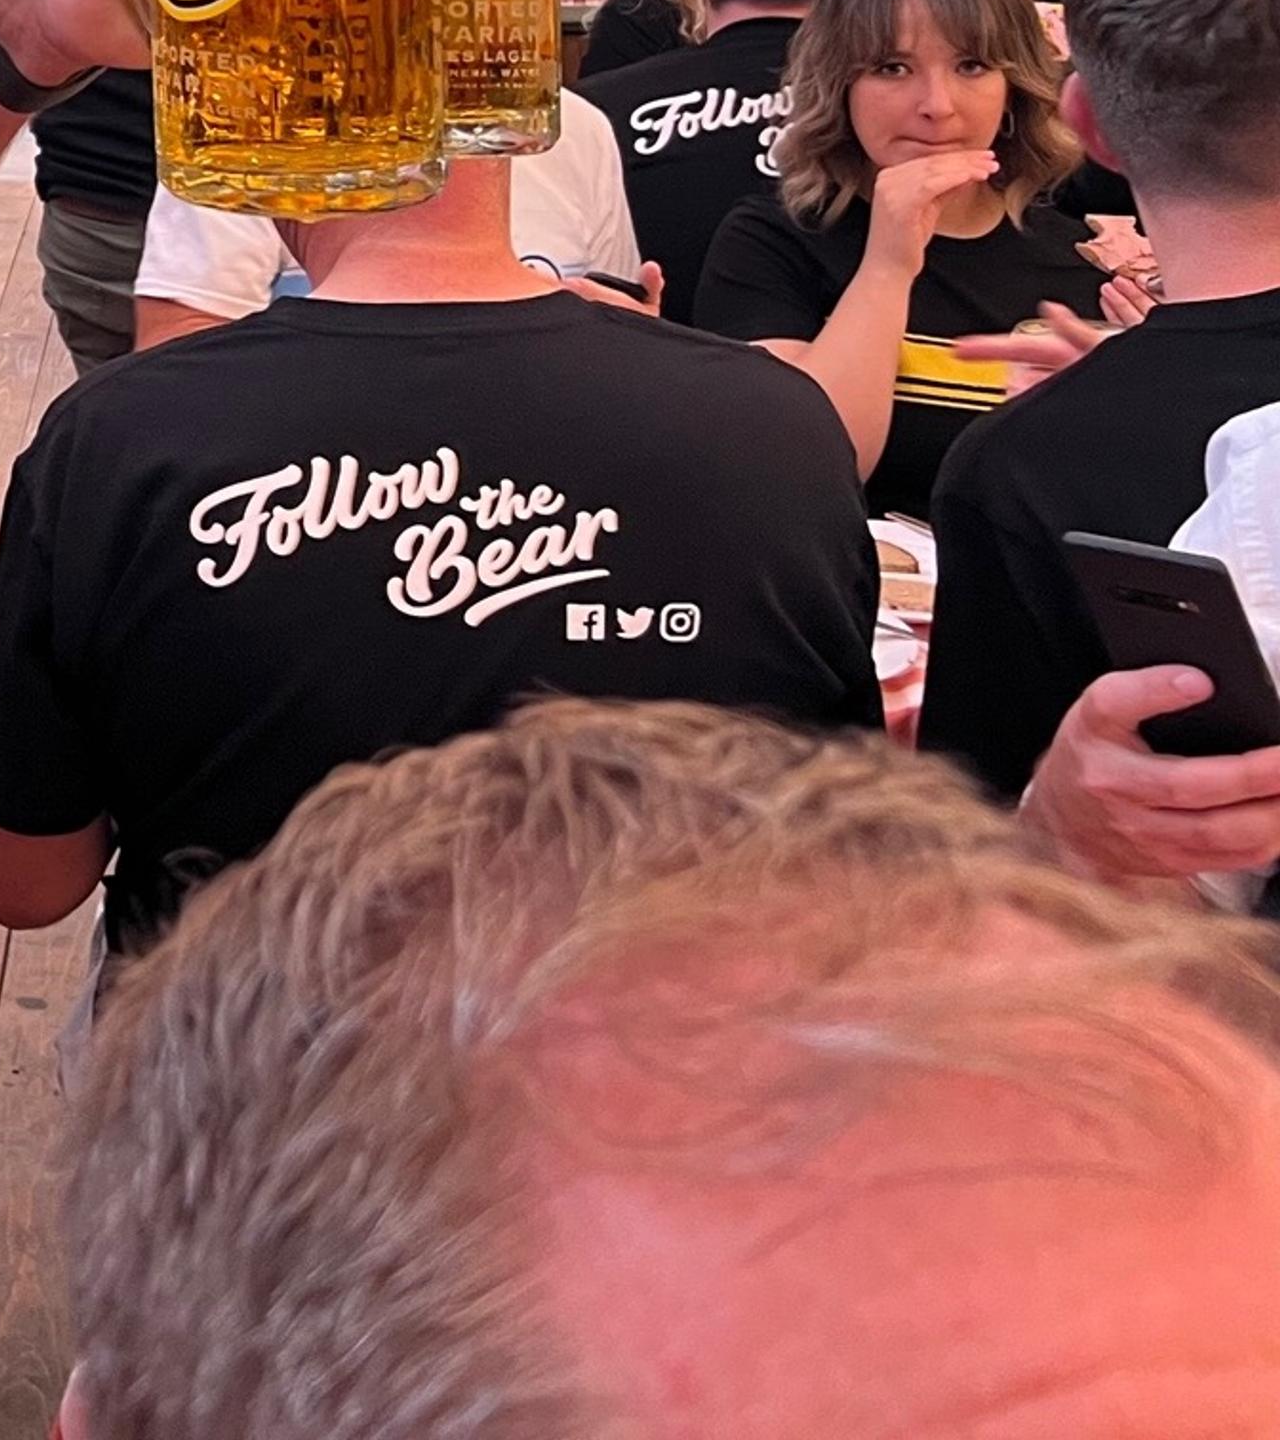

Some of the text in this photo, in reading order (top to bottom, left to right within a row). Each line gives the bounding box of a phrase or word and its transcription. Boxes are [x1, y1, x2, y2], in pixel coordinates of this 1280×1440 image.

[189, 446, 565, 588] Follow the
[386, 514, 619, 617] Bear
